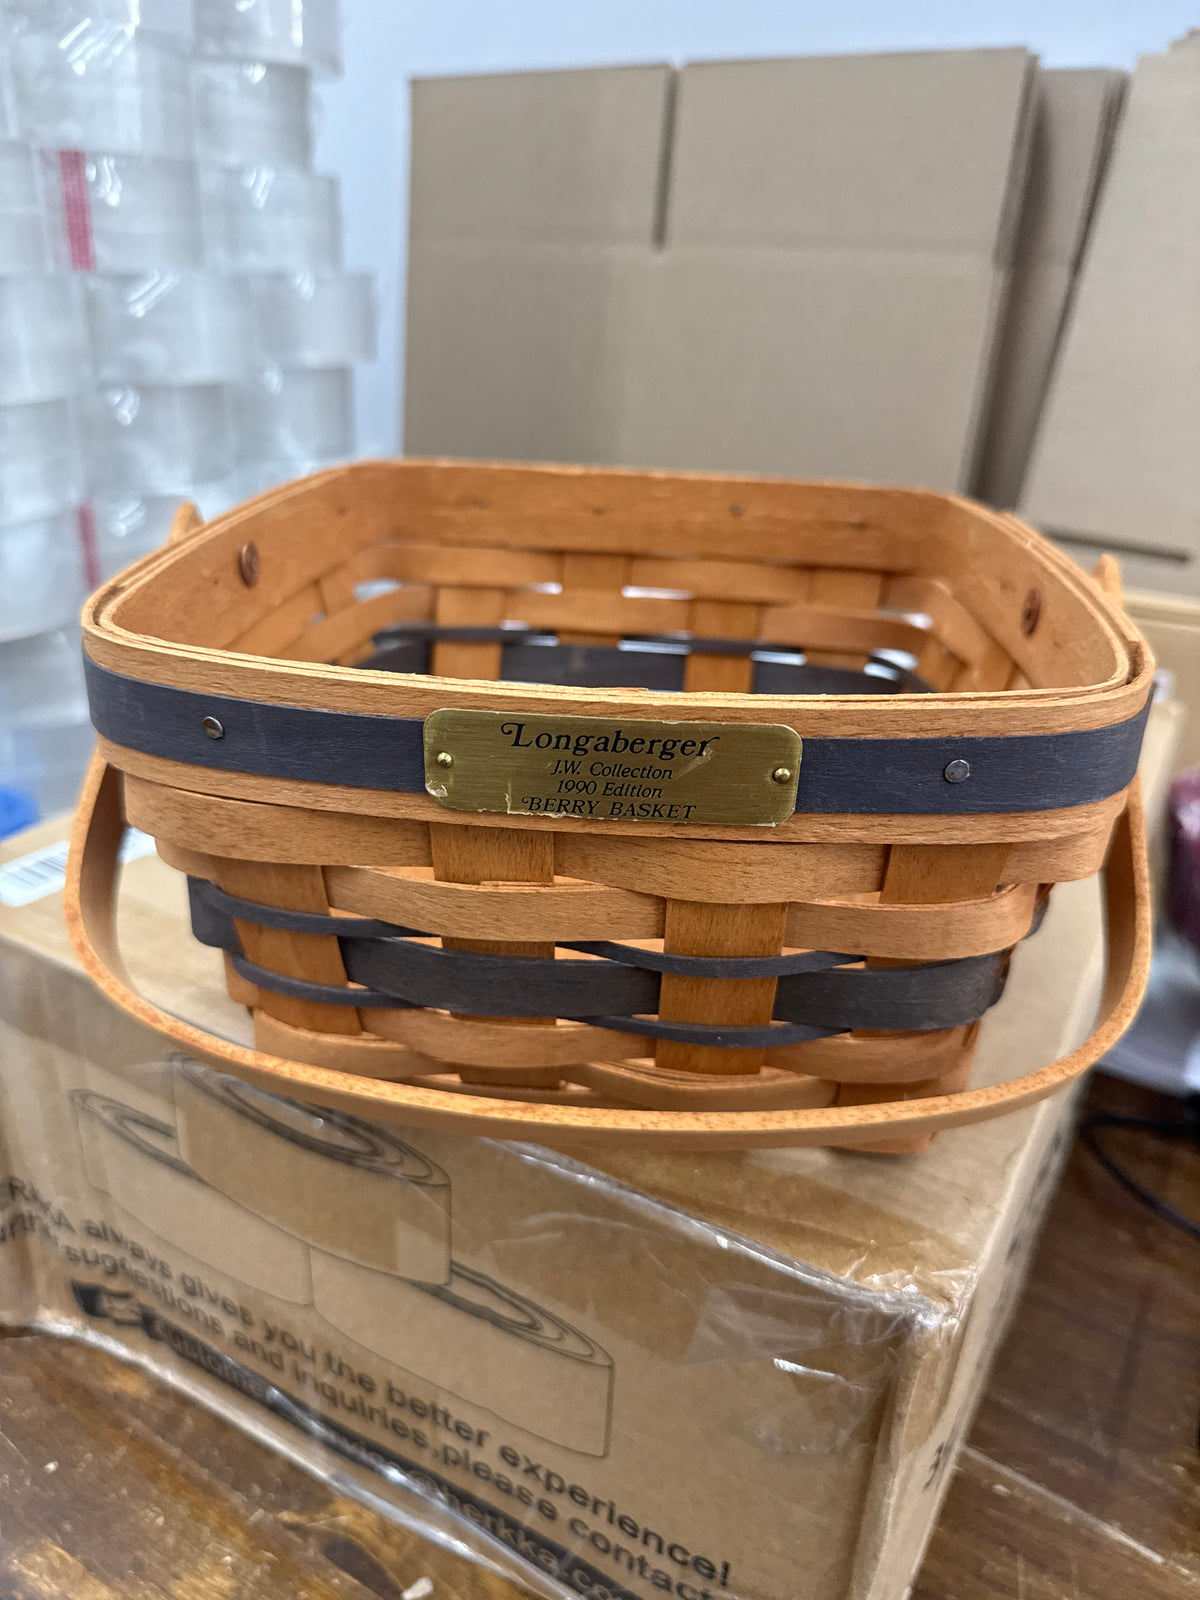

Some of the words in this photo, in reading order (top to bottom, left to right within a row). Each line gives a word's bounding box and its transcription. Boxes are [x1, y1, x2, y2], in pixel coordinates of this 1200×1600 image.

[500, 722, 720, 762] Longaberger
[550, 760, 582, 777] J.W.
[589, 762, 673, 780] Collection
[556, 779, 597, 797] 1990
[601, 782, 663, 800] Edition
[521, 796, 601, 816] BERRY
[608, 801, 697, 820] BASKET
[233, 1331, 285, 1371] and
[180, 1271, 254, 1327] gives
[264, 1318, 317, 1365] you
[323, 1350, 376, 1395] the
[386, 1379, 491, 1448] better
[498, 1444, 731, 1588] experience!
